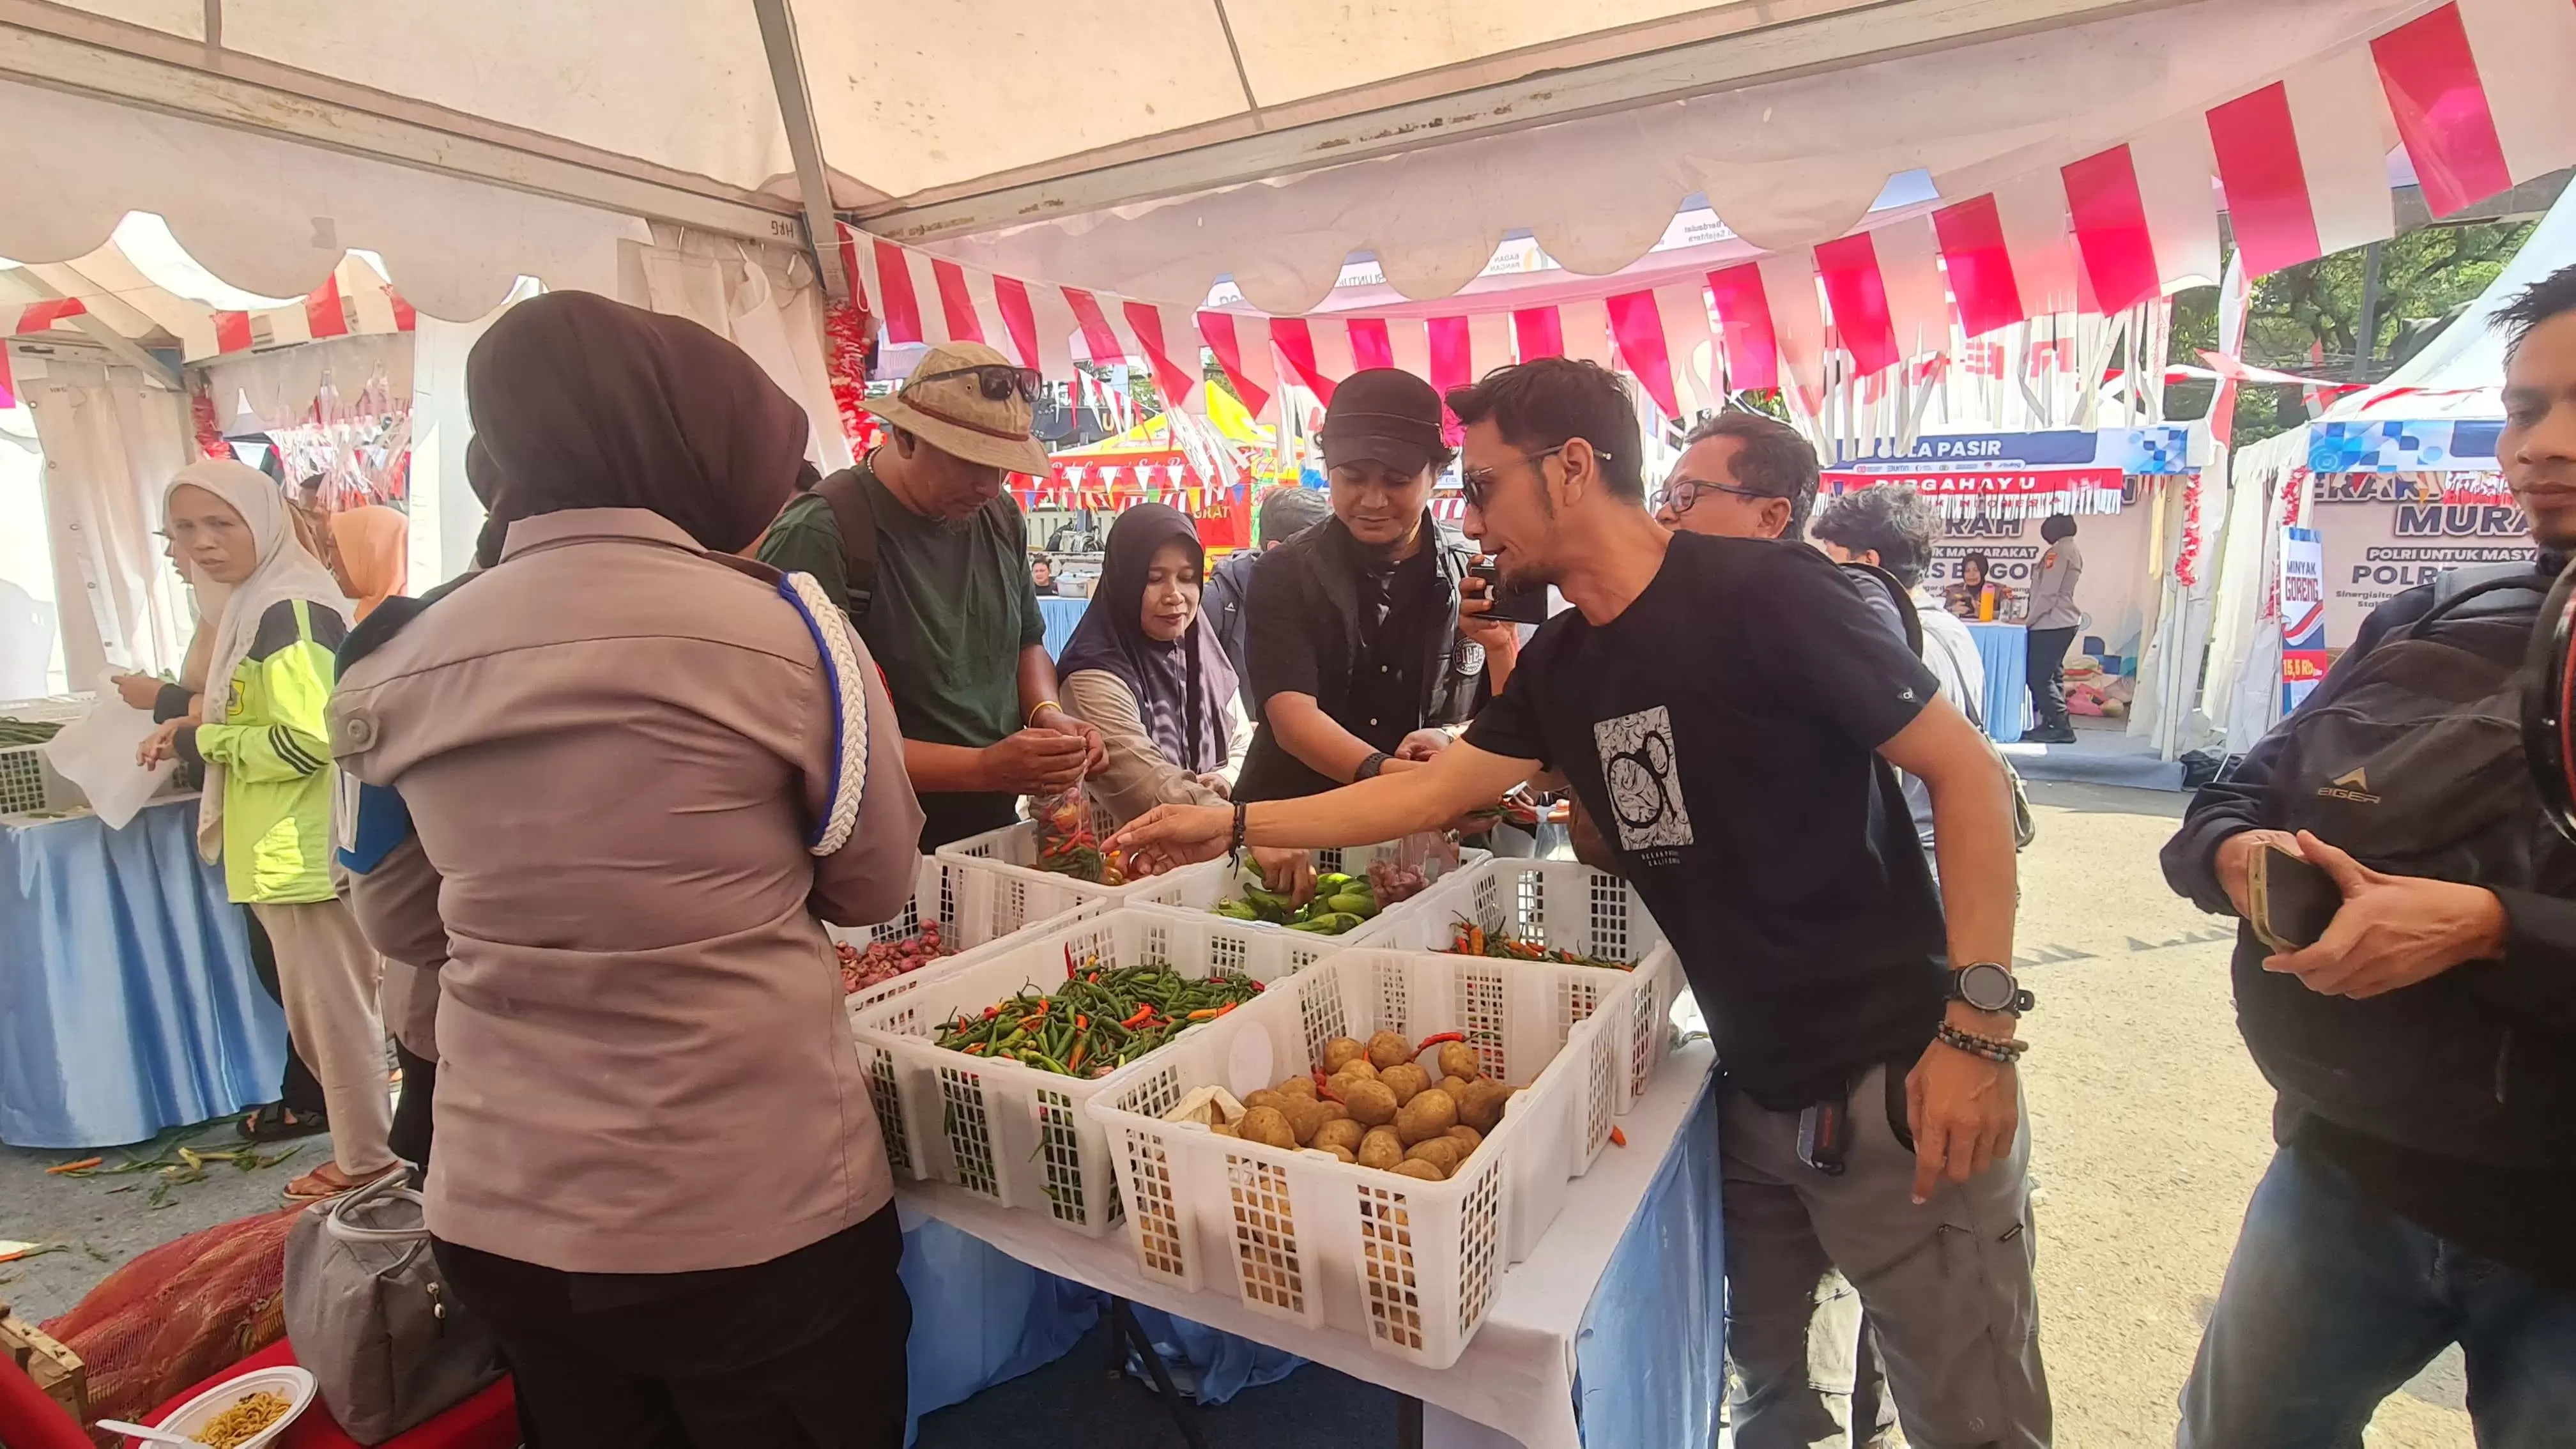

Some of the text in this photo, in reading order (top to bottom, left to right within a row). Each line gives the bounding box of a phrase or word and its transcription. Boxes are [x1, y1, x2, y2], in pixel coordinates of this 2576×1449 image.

[1937, 440, 2001, 457] PASIR
[1944, 512, 2021, 535] RAH
[2400, 505, 2530, 533] MURA
[2369, 549, 2536, 561] POLRI UNTUK MASY
[2286, 560, 2317, 575] MINYAK
[2285, 576, 2319, 602] GORENG
[2335, 590, 2396, 601] Sinergisita
[1455, 646, 1483, 664] EIGER
[2317, 786, 2380, 804] EIGER
